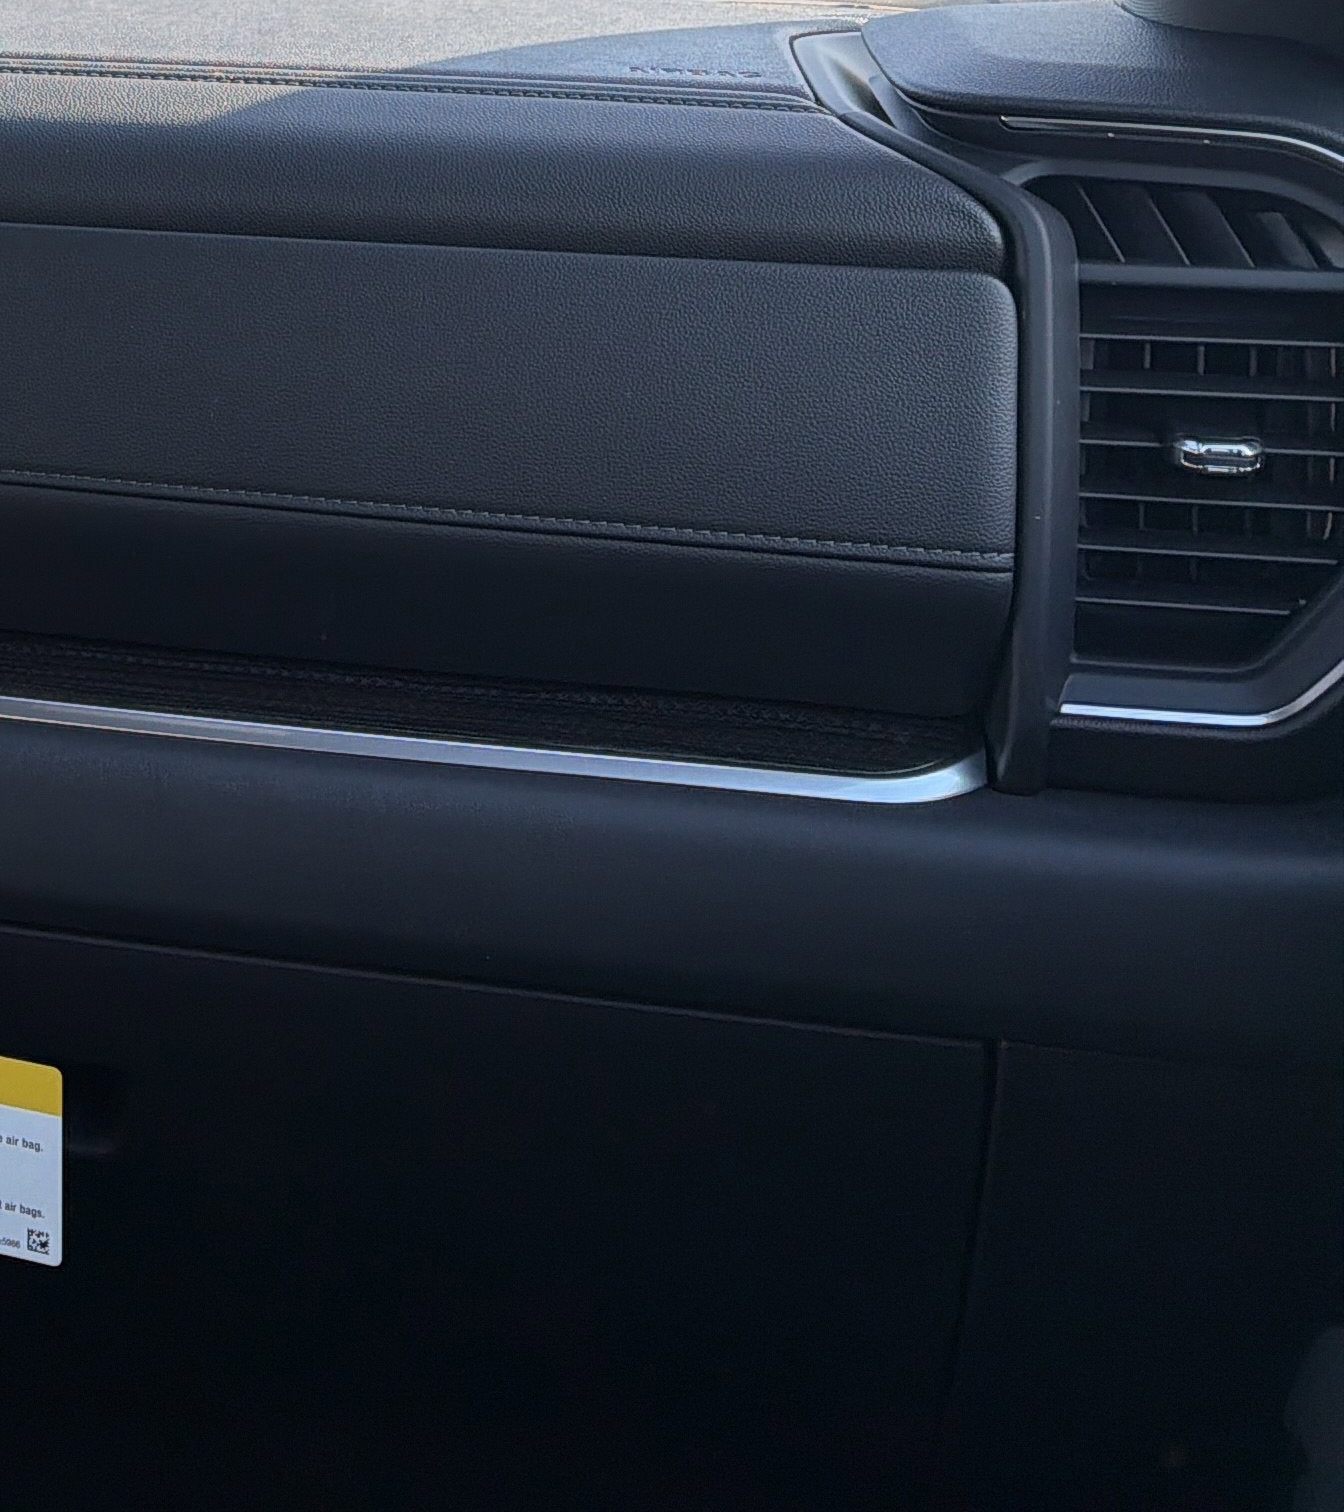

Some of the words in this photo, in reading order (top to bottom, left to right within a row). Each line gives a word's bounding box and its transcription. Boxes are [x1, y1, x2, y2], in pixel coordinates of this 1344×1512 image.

[6, 1136, 19, 1146] air
[22, 1138, 43, 1152] bag.
[5, 1202, 16, 1212] air
[19, 1204, 45, 1219] bags.
